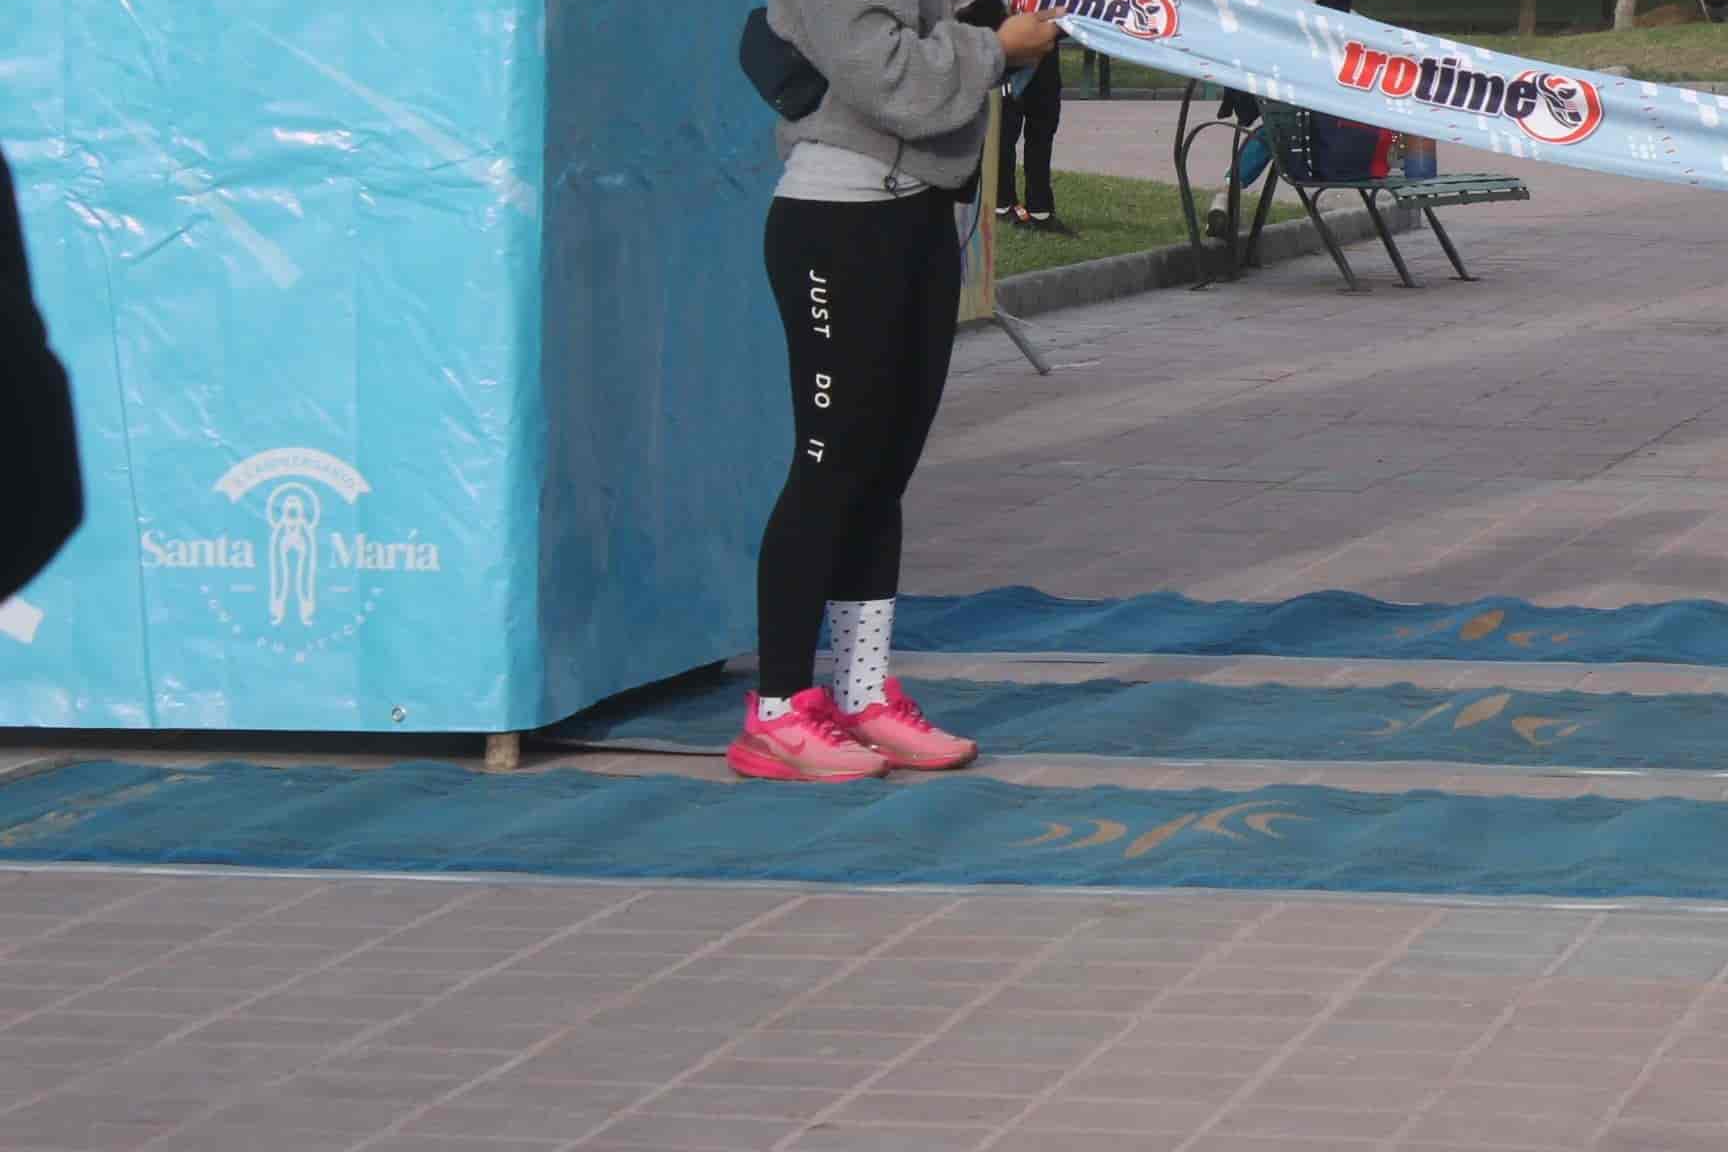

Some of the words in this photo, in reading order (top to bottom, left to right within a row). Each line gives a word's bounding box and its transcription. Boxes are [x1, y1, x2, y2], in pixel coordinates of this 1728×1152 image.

[1337, 40, 1537, 119] trotime
[809, 269, 832, 339] JUST
[814, 373, 832, 409] DO
[807, 438, 825, 464] IT
[140, 530, 257, 569] Santa
[328, 528, 441, 571] María
